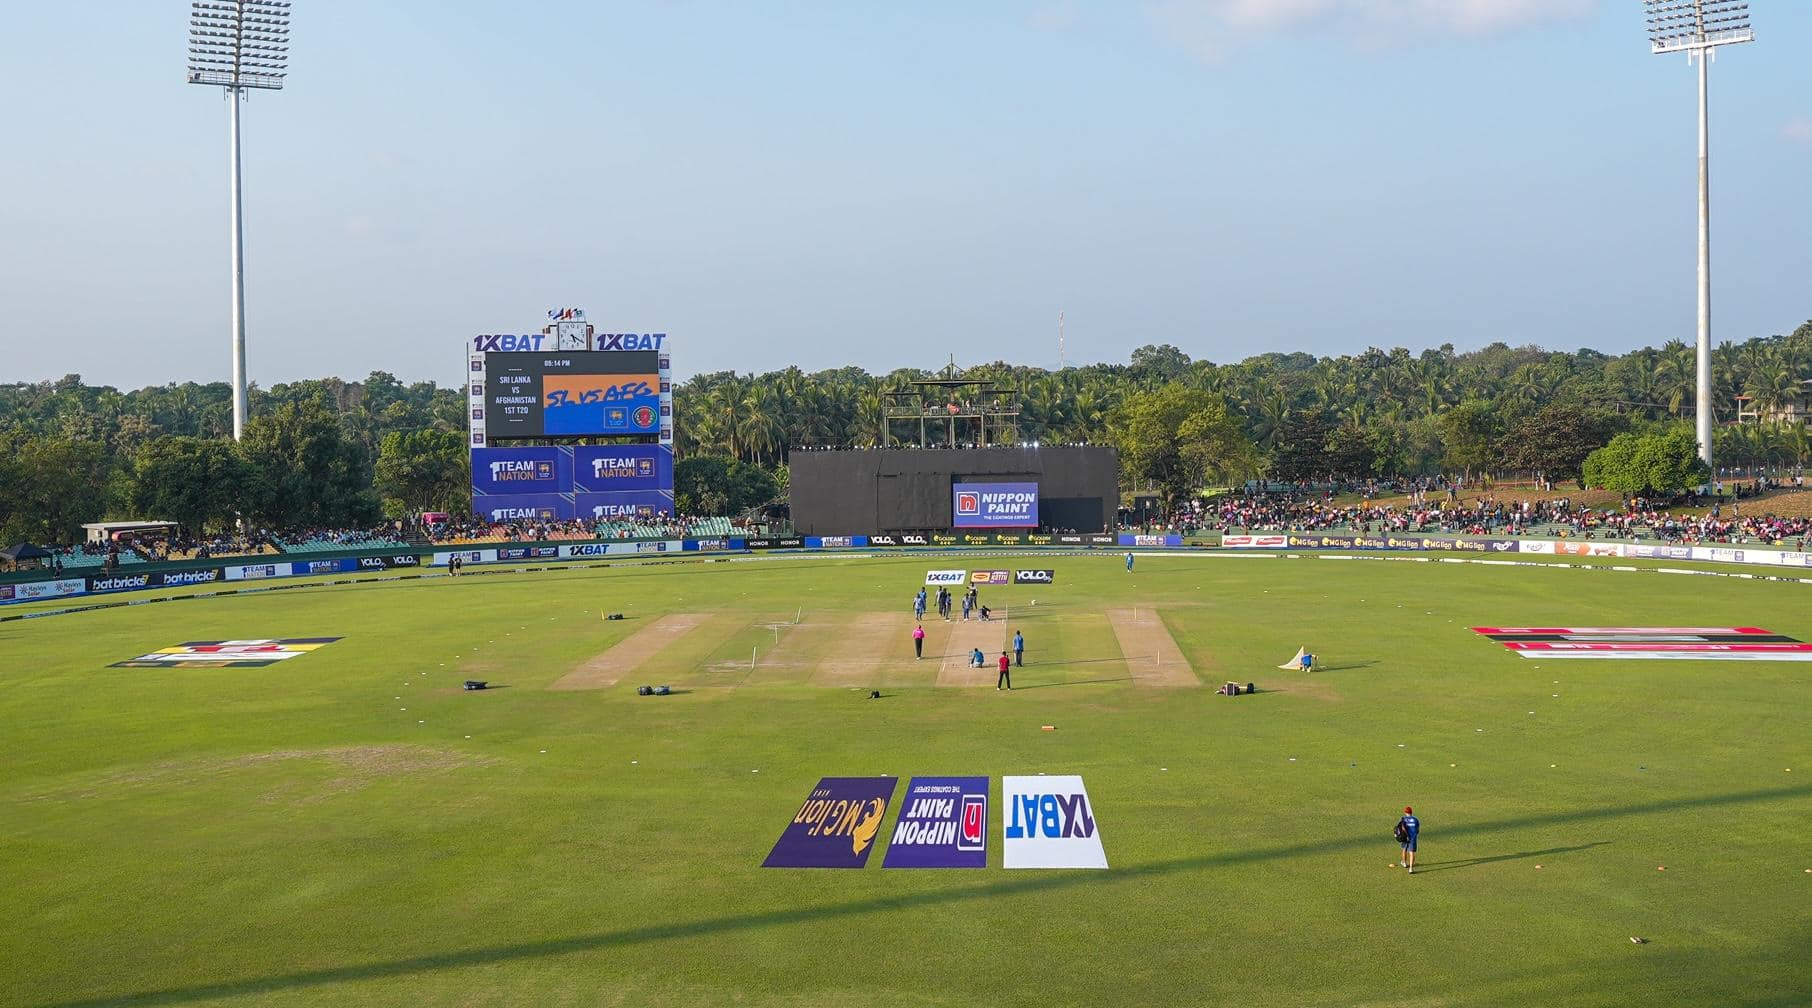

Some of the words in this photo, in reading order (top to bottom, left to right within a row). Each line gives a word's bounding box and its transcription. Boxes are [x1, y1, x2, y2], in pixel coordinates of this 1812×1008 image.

[474, 334, 546, 351] 1XBAT
[597, 334, 666, 350] 1XBAT
[500, 461, 534, 471] TEAM
[601, 458, 635, 468] TEAM
[500, 471, 534, 480] NATION
[601, 468, 635, 477] NATION
[982, 493, 1035, 503] NIPPON
[501, 508, 535, 519] TEAM
[602, 505, 636, 515] TEAM
[988, 504, 1029, 513] PAINT
[569, 544, 609, 556] 1XBAT
[361, 558, 381, 566] YOLO
[393, 556, 413, 564] YOLO
[164, 574, 183, 584] bat
[1016, 571, 1046, 580] YOLO
[92, 579, 112, 590] bat
[906, 799, 954, 818] PAINT
[1006, 794, 1094, 838] 1XBAT
[892, 821, 957, 845] NIPPON
